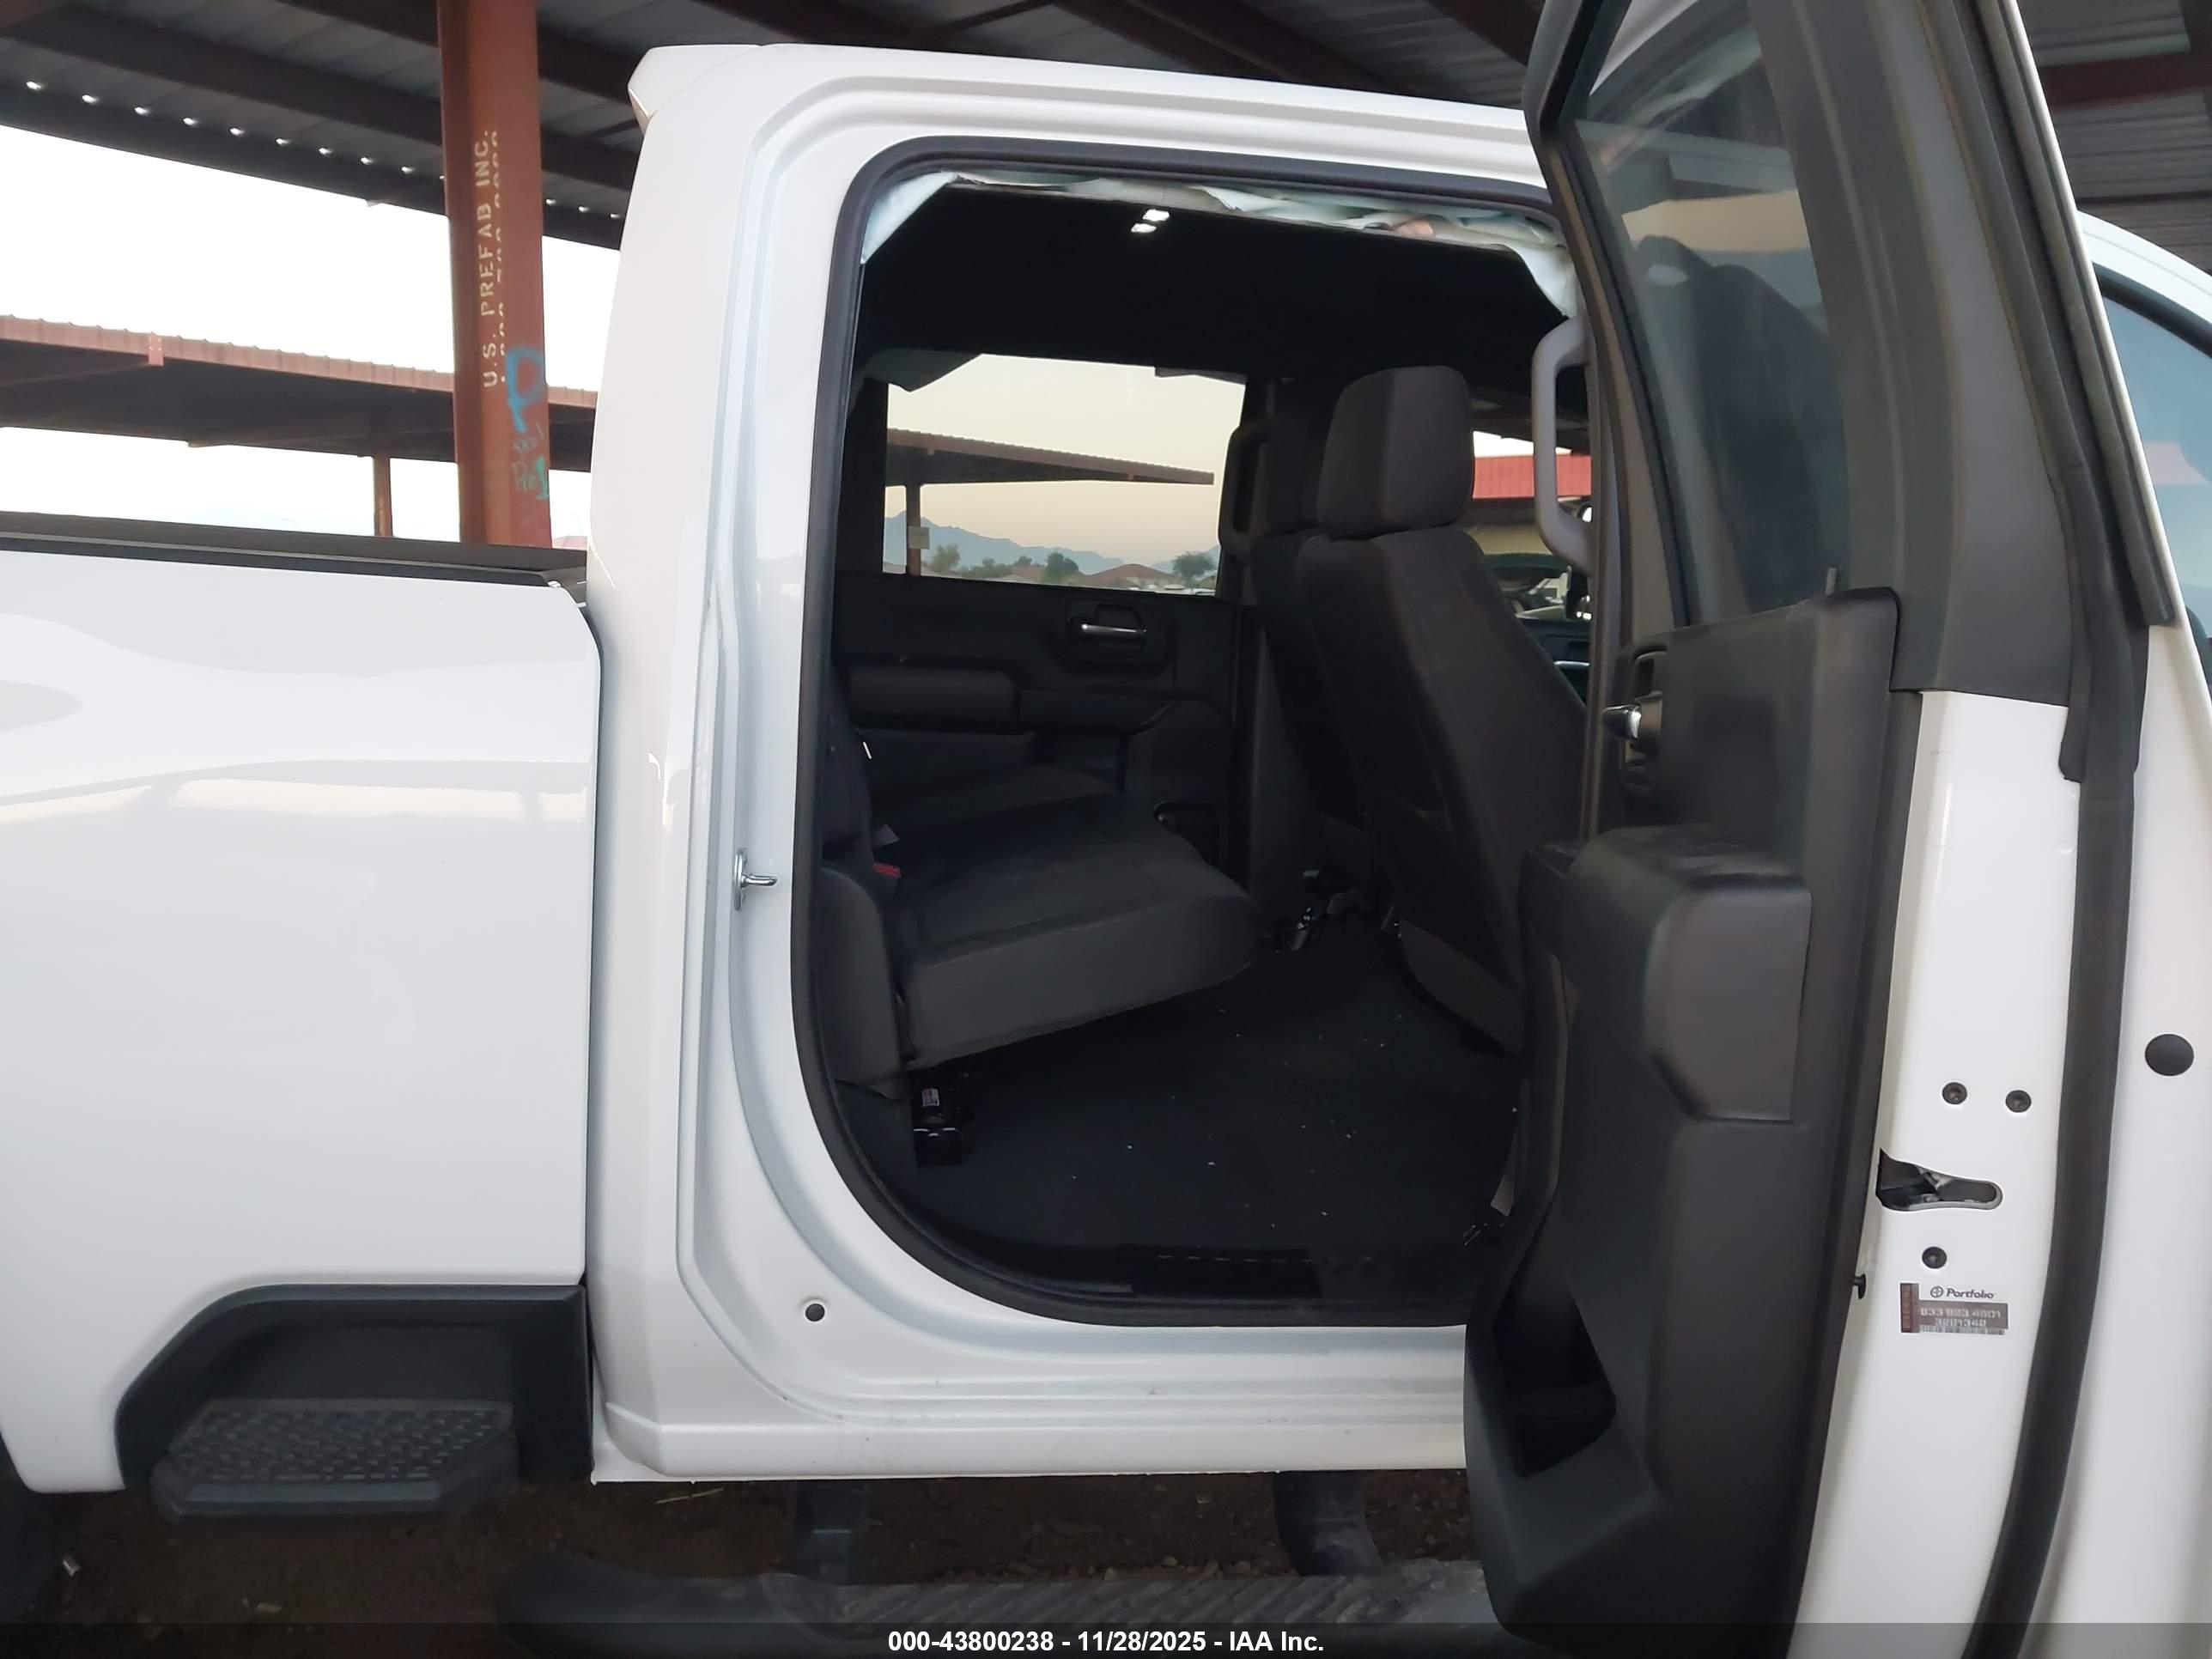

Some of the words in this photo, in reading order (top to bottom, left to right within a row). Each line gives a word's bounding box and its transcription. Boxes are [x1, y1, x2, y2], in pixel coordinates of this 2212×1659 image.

[474, 131, 490, 186] INC.
[477, 203, 495, 316] PREFAB
[483, 333, 498, 387] U.S.
[1946, 1287, 1994, 1299] Portfolio
